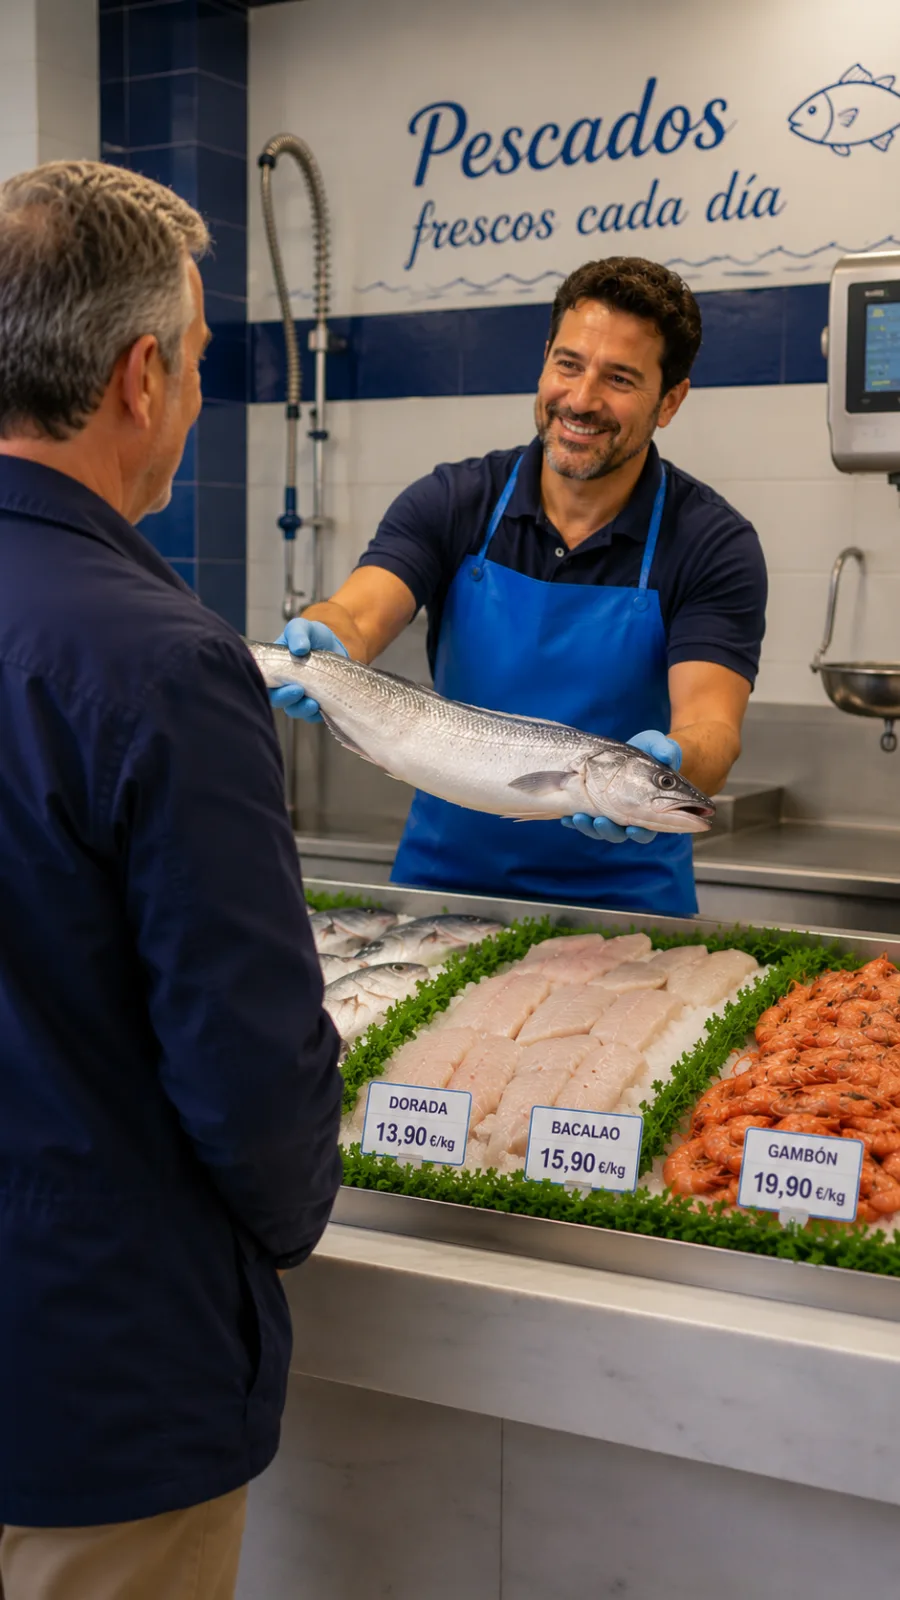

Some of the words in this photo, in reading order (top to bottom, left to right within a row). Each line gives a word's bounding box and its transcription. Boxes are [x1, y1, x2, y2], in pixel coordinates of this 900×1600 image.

[408, 76, 730, 187] Pescados
[403, 200, 556, 270] frescos
[577, 178, 686, 235] cada
[705, 170, 783, 222] día
[389, 1096, 448, 1115] DORADA
[376, 1122, 427, 1146] 13,90
[429, 1135, 456, 1152] €/kg
[551, 1121, 620, 1140] BACALAO
[540, 1148, 596, 1173] 15,90
[598, 1161, 626, 1179] €/kg
[768, 1143, 838, 1166] GAMBÓN
[754, 1171, 812, 1199] 19,90
[815, 1186, 846, 1207] €/kg
